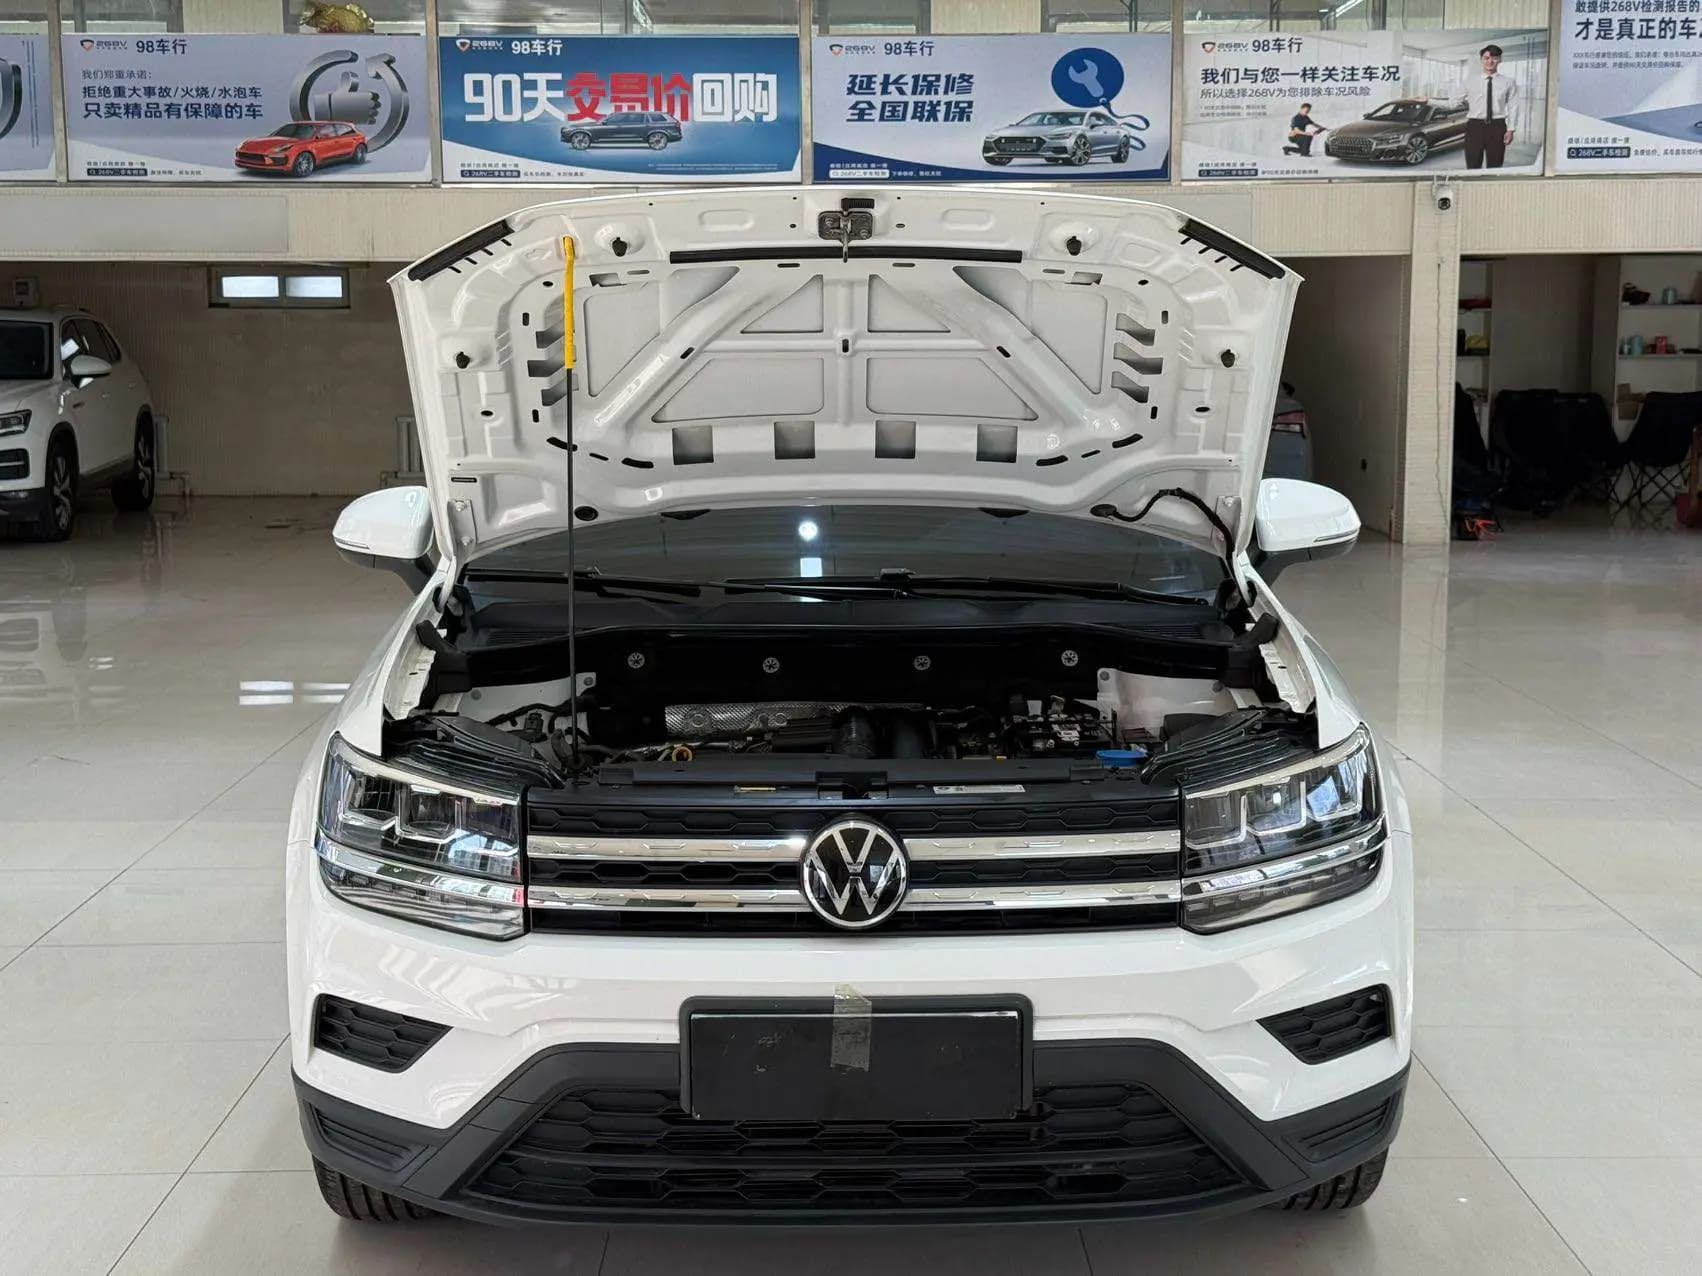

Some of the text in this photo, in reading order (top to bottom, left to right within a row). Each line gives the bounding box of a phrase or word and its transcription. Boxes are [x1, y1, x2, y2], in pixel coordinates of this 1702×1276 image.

[1575, 0, 1700, 13] 敢提供268V检测报告的
[1575, 17, 1702, 41] 才是真正的车
[136, 38, 187, 54] 98车行
[511, 39, 563, 56] 98车行
[884, 40, 934, 57] 98车行
[1252, 37, 1303, 54] 98车行
[1200, 65, 1401, 84] 我们与您一样关注车况
[82, 86, 263, 99] 拒绝重大事故/火烧/水泡车
[846, 73, 974, 96] 延长保修
[1200, 85, 1371, 99] 所以选择268V为您排除车况风险
[463, 71, 778, 123] 90天交易价回购
[83, 102, 263, 120] 只卖精品有保障的车
[846, 100, 974, 122] 全国联保
